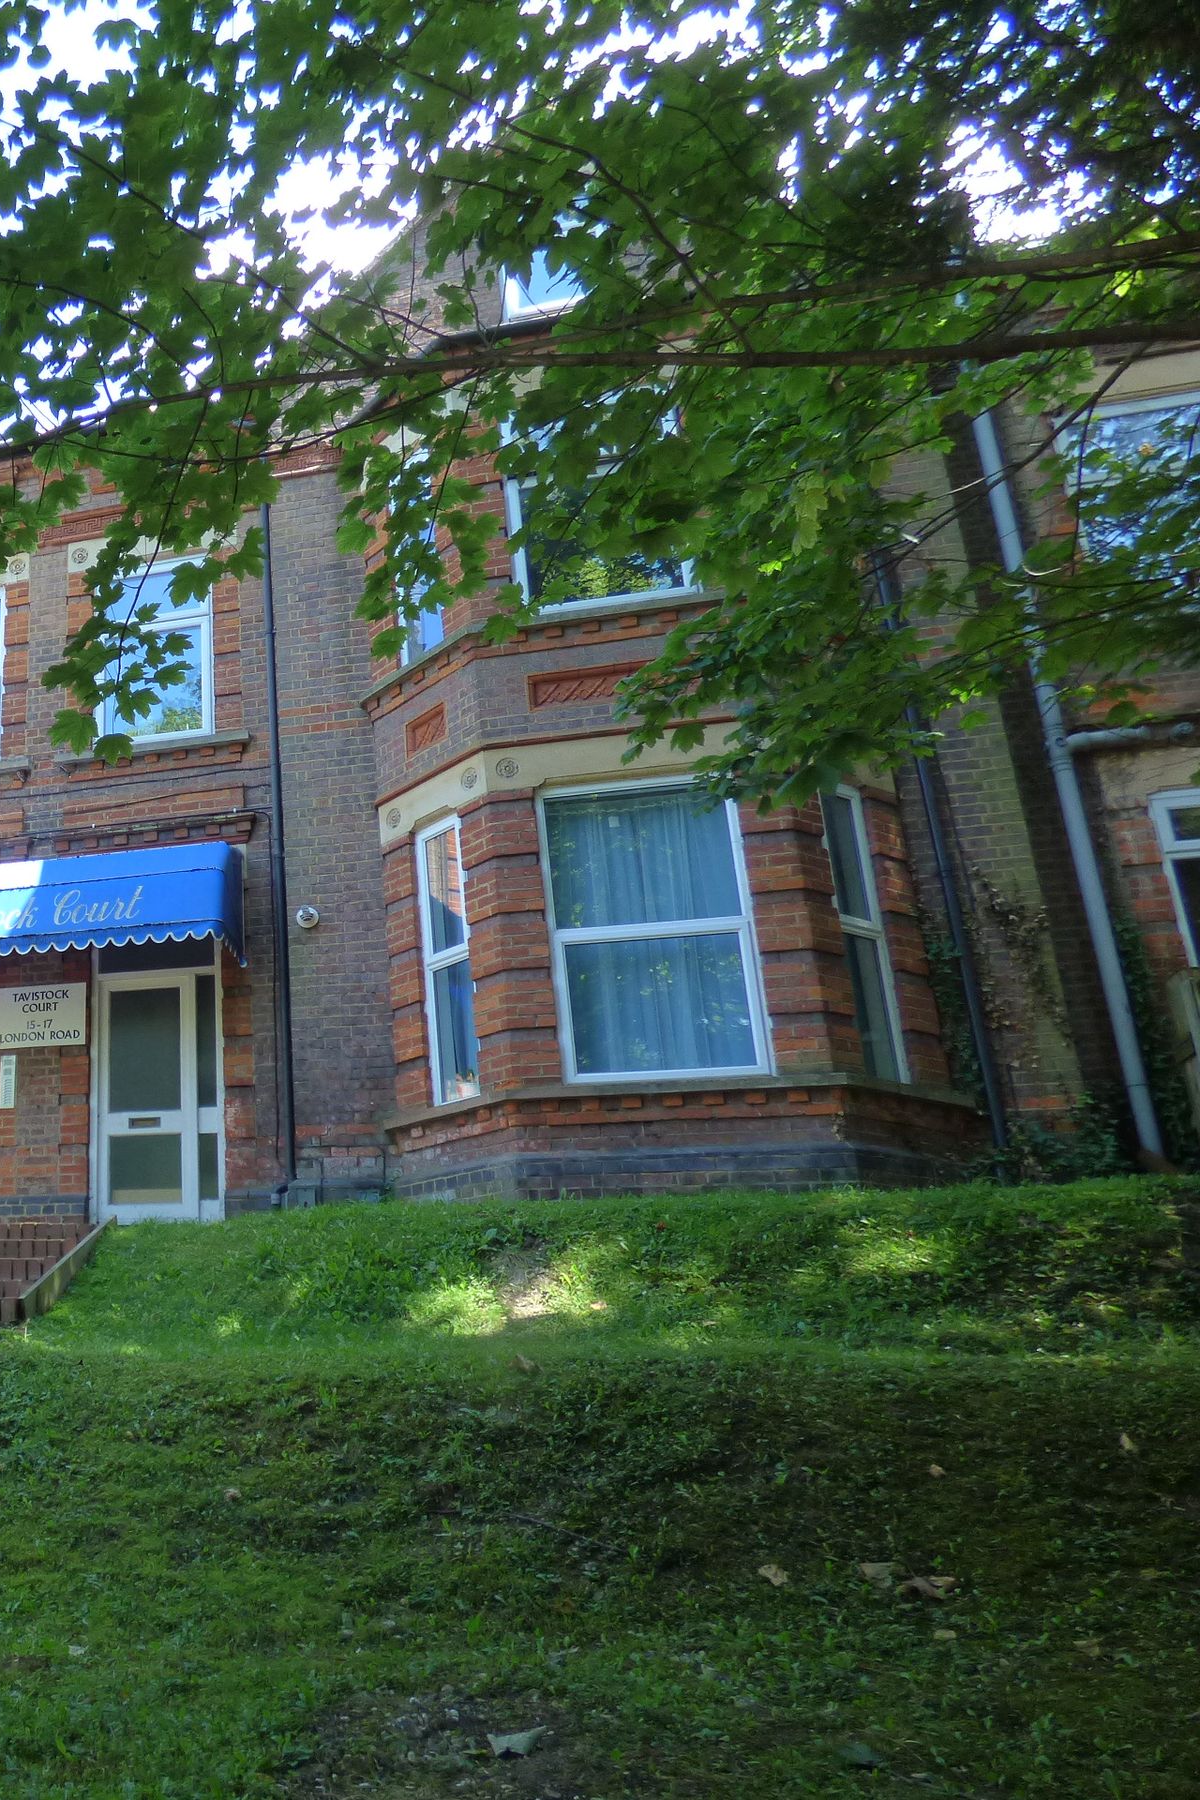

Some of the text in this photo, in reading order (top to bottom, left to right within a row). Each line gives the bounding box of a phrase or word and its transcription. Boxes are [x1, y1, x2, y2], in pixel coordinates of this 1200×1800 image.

[53, 885, 144, 926] Court
[12, 989, 70, 1002] TAVISTOCK
[22, 1002, 59, 1013] COURT
[0, 1029, 81, 1043] LONDON ROAD
